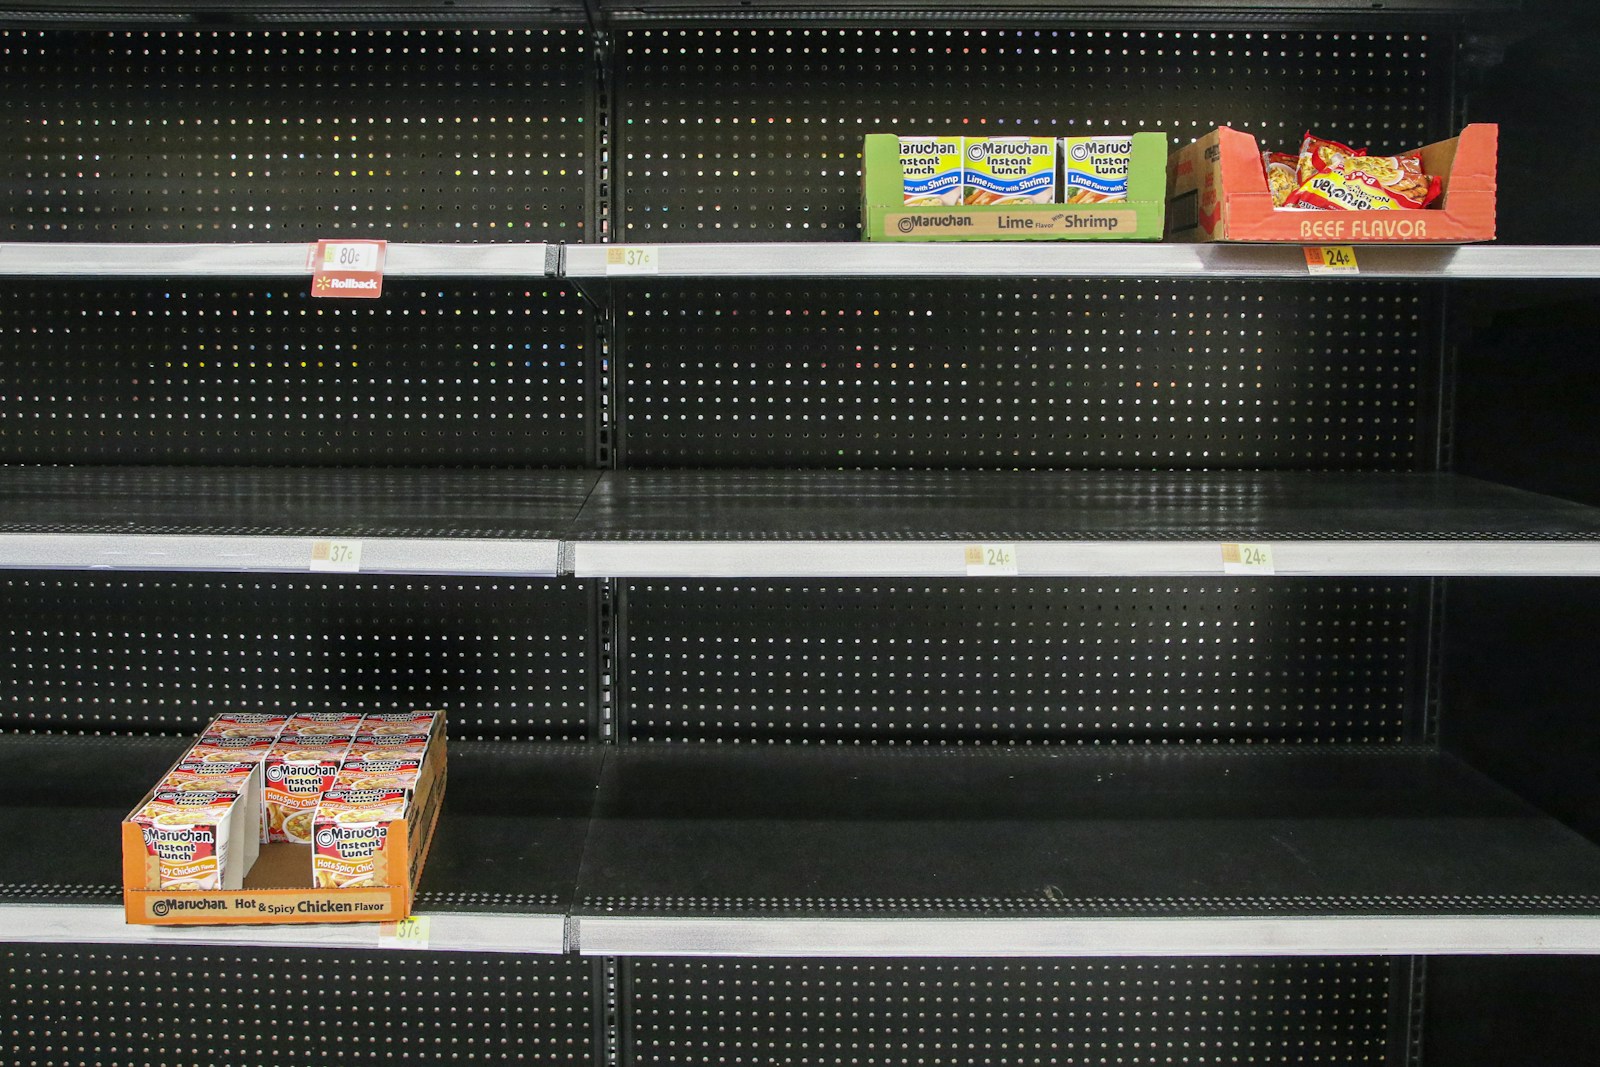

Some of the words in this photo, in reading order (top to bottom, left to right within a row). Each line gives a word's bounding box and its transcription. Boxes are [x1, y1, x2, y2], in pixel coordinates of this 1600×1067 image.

[899, 142, 956, 154] aruchan
[983, 142, 1048, 155] Maruchan
[900, 157, 939, 166] nstant
[987, 156, 1031, 166] Instant
[1091, 156, 1130, 166] Instan
[903, 166, 934, 174] unch
[992, 166, 1026, 174] Lunch
[928, 175, 959, 190] Shrimp
[967, 174, 987, 187] Lime
[987, 183, 1005, 191] Flavor
[1019, 176, 1051, 190] Shrimp
[1071, 174, 1091, 187] Lime
[1091, 183, 1109, 191] Flavor
[911, 215, 972, 227] Maruchan
[998, 216, 1033, 229] Lime
[1065, 215, 1118, 231] Shrimp
[1300, 220, 1344, 237] BEEF
[1352, 220, 1426, 237] FLAVOR
[331, 278, 377, 289] Rollback
[280, 765, 336, 776] Maruchan
[285, 777, 322, 786] Instant
[149, 828, 211, 841] Maruchan
[331, 826, 387, 839] Marucha
[153, 841, 195, 852] Instant
[337, 839, 380, 850] Instant
[160, 851, 191, 860] Lunch
[173, 865, 200, 876] Chicken
[166, 898, 225, 910] Maruchan
[235, 899, 256, 908] Hot
[259, 903, 266, 912] &
[268, 904, 295, 914] Spicy
[298, 900, 352, 913] Chicken
[355, 902, 384, 911] Flavor
